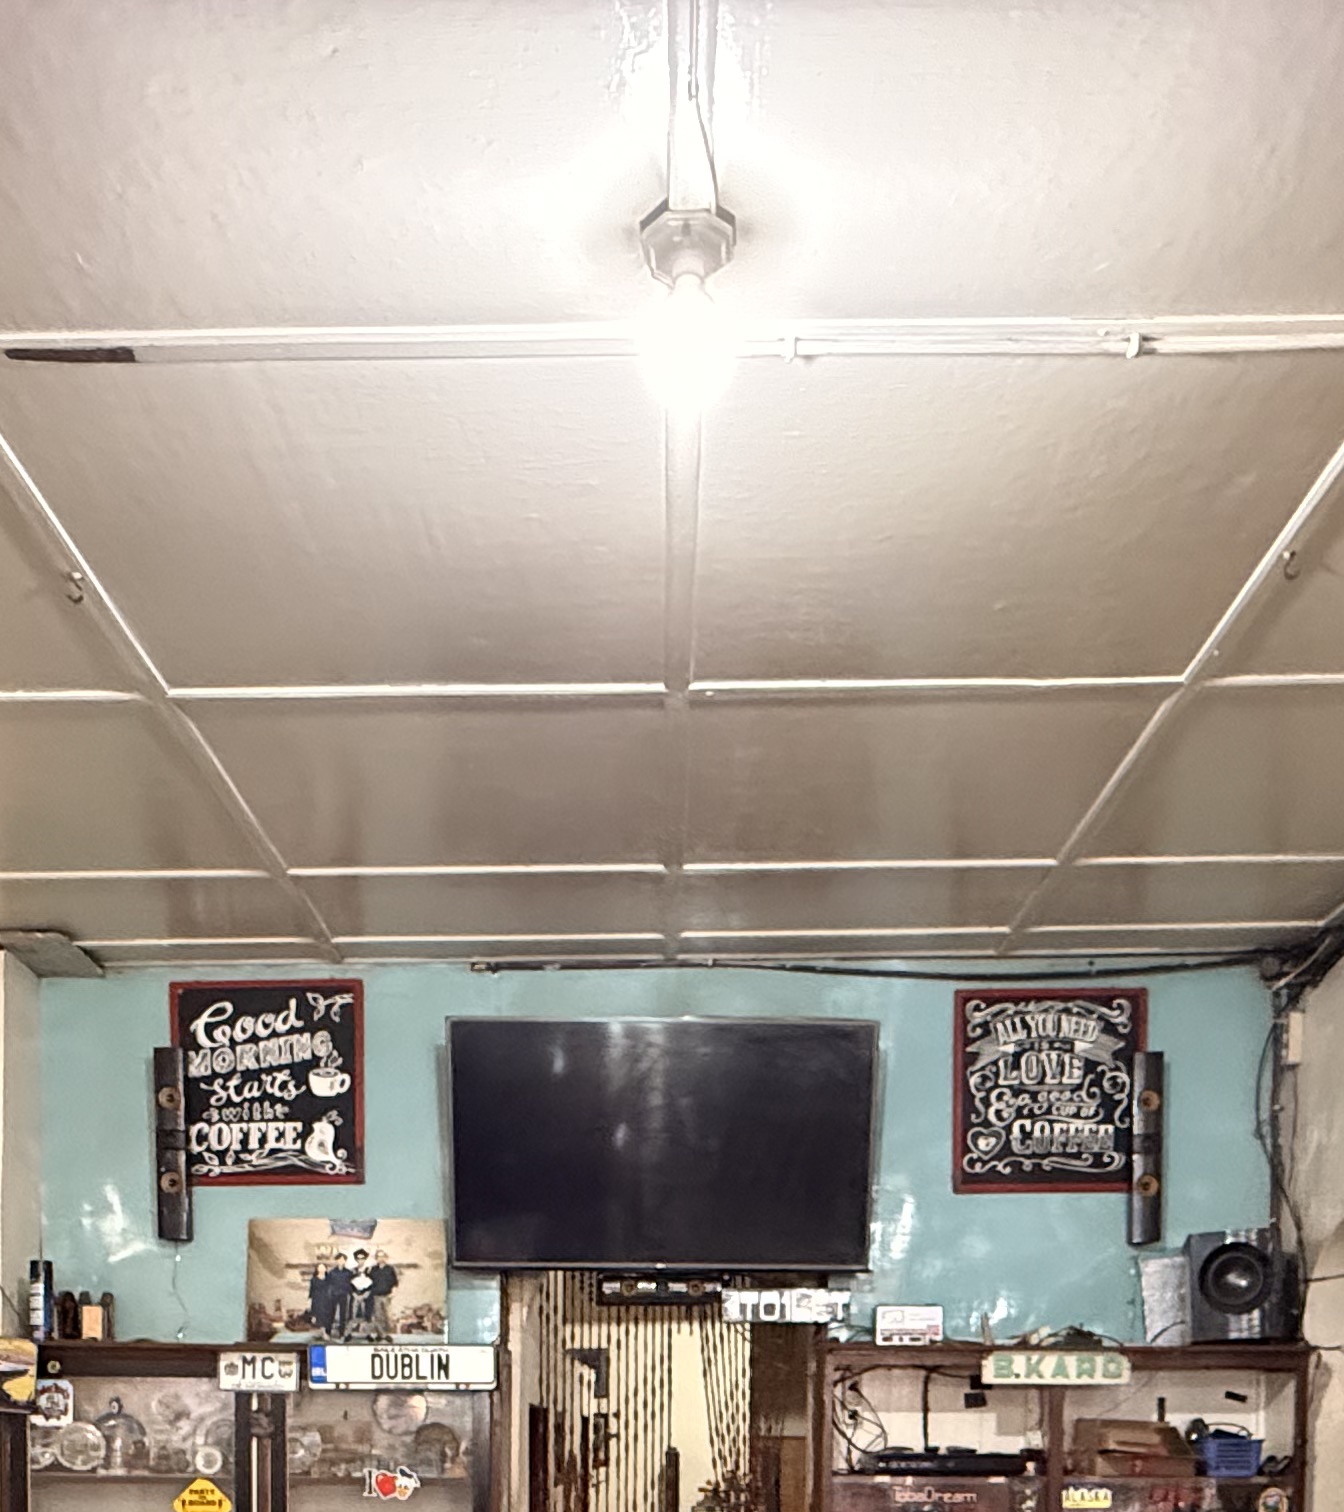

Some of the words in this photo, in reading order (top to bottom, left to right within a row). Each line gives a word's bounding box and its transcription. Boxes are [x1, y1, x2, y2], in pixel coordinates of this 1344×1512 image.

[190, 998, 304, 1048] Good
[995, 1016, 1029, 1045] ALL
[1025, 1012, 1059, 1038] YOU
[1059, 1013, 1098, 1043] NEED
[187, 1030, 334, 1078] MORNING
[998, 1051, 1085, 1085] LOVE
[189, 1121, 303, 1154] COFFEE
[1010, 1119, 1115, 1155] COFFEE
[371, 1353, 450, 1380] DUBLIN
